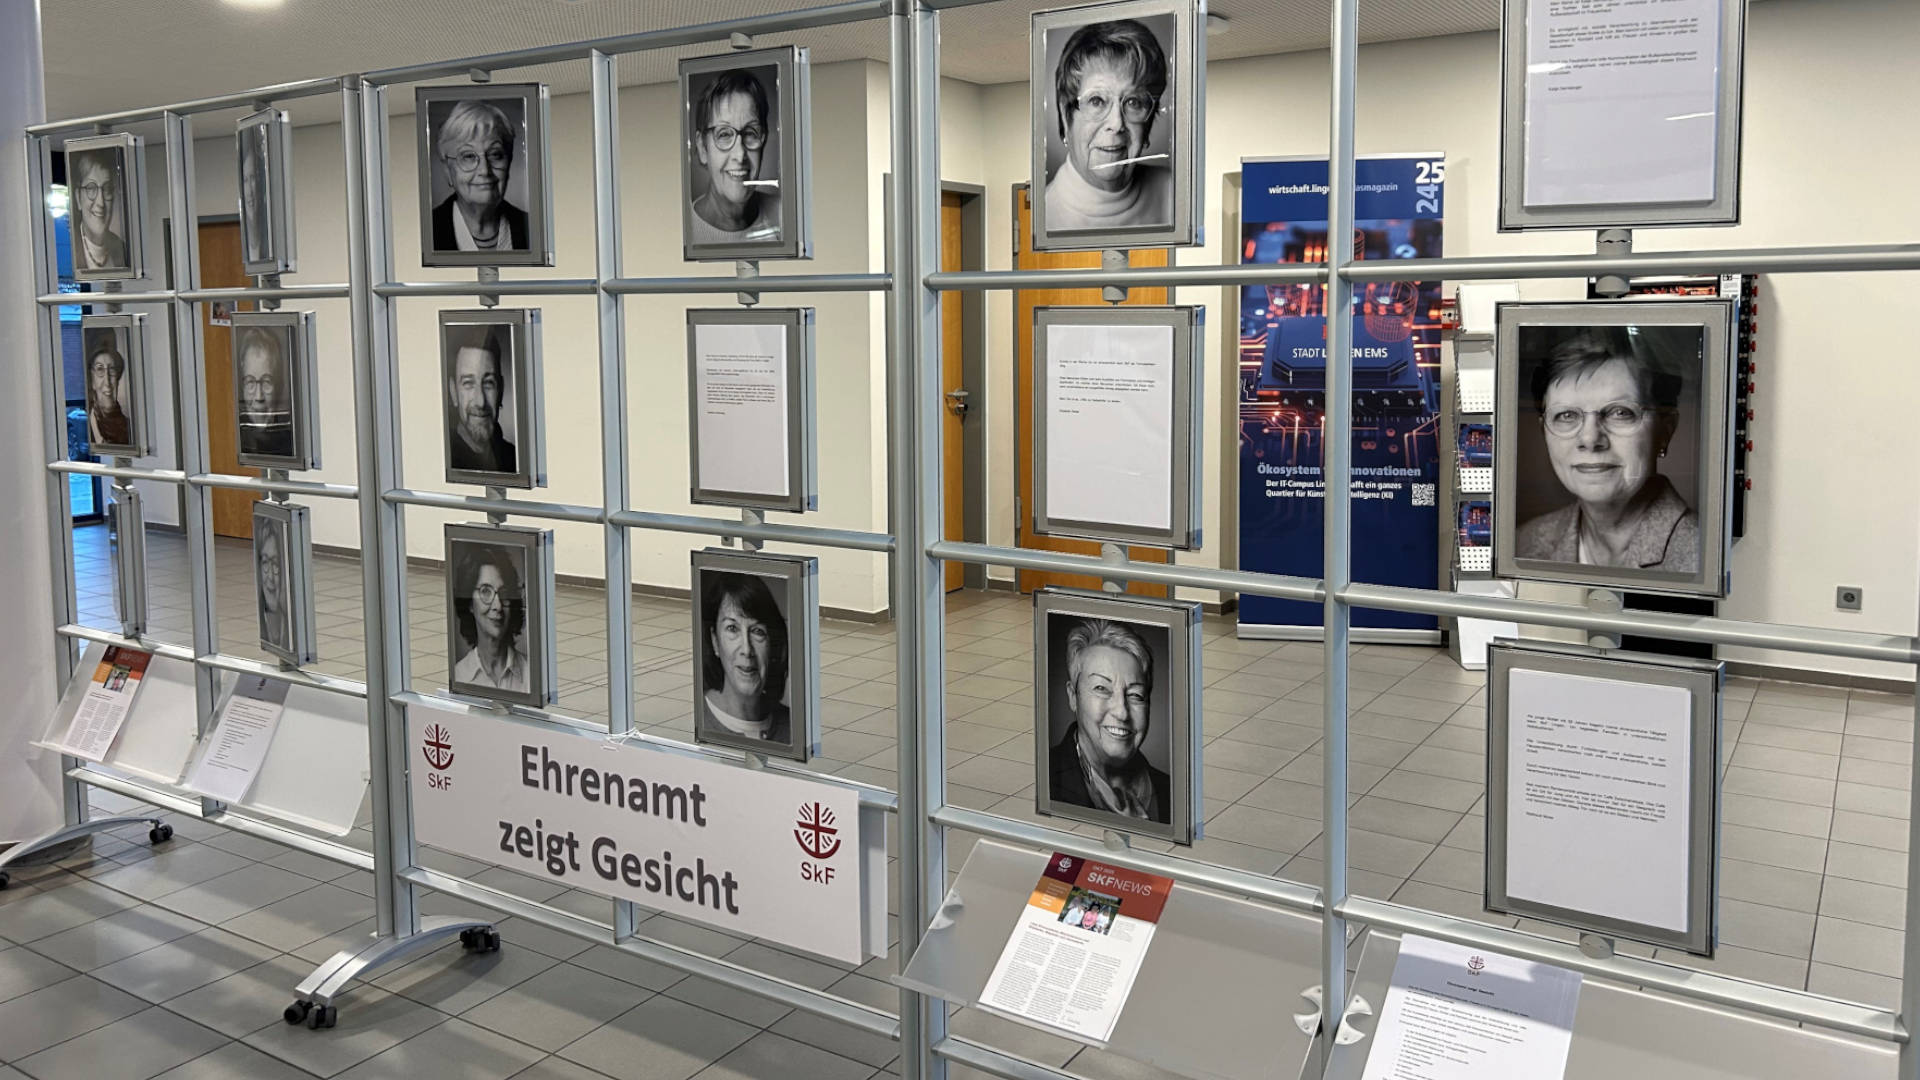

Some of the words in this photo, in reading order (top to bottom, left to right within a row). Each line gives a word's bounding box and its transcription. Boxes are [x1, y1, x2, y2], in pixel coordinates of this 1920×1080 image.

[1415, 161, 1445, 184] 25
[1416, 184, 1438, 214] 24
[1292, 347, 1320, 358] STADT
[1364, 347, 1388, 358] EMS
[1257, 462, 1321, 477] Ökosystem
[1266, 480, 1279, 488] Der
[1280, 480, 1314, 490] IT-Campus
[1365, 481, 1376, 489] ein
[1377, 482, 1402, 491] ganzes
[1266, 489, 1294, 498] Quartier
[1295, 489, 1306, 498] für
[427, 771, 452, 792] SkF
[521, 743, 707, 828] Ehrenamt
[499, 818, 580, 877] zeigt
[591, 836, 739, 916] Gesicht
[800, 861, 835, 886] SkF
[1087, 871, 1152, 897] SKFNEWS
